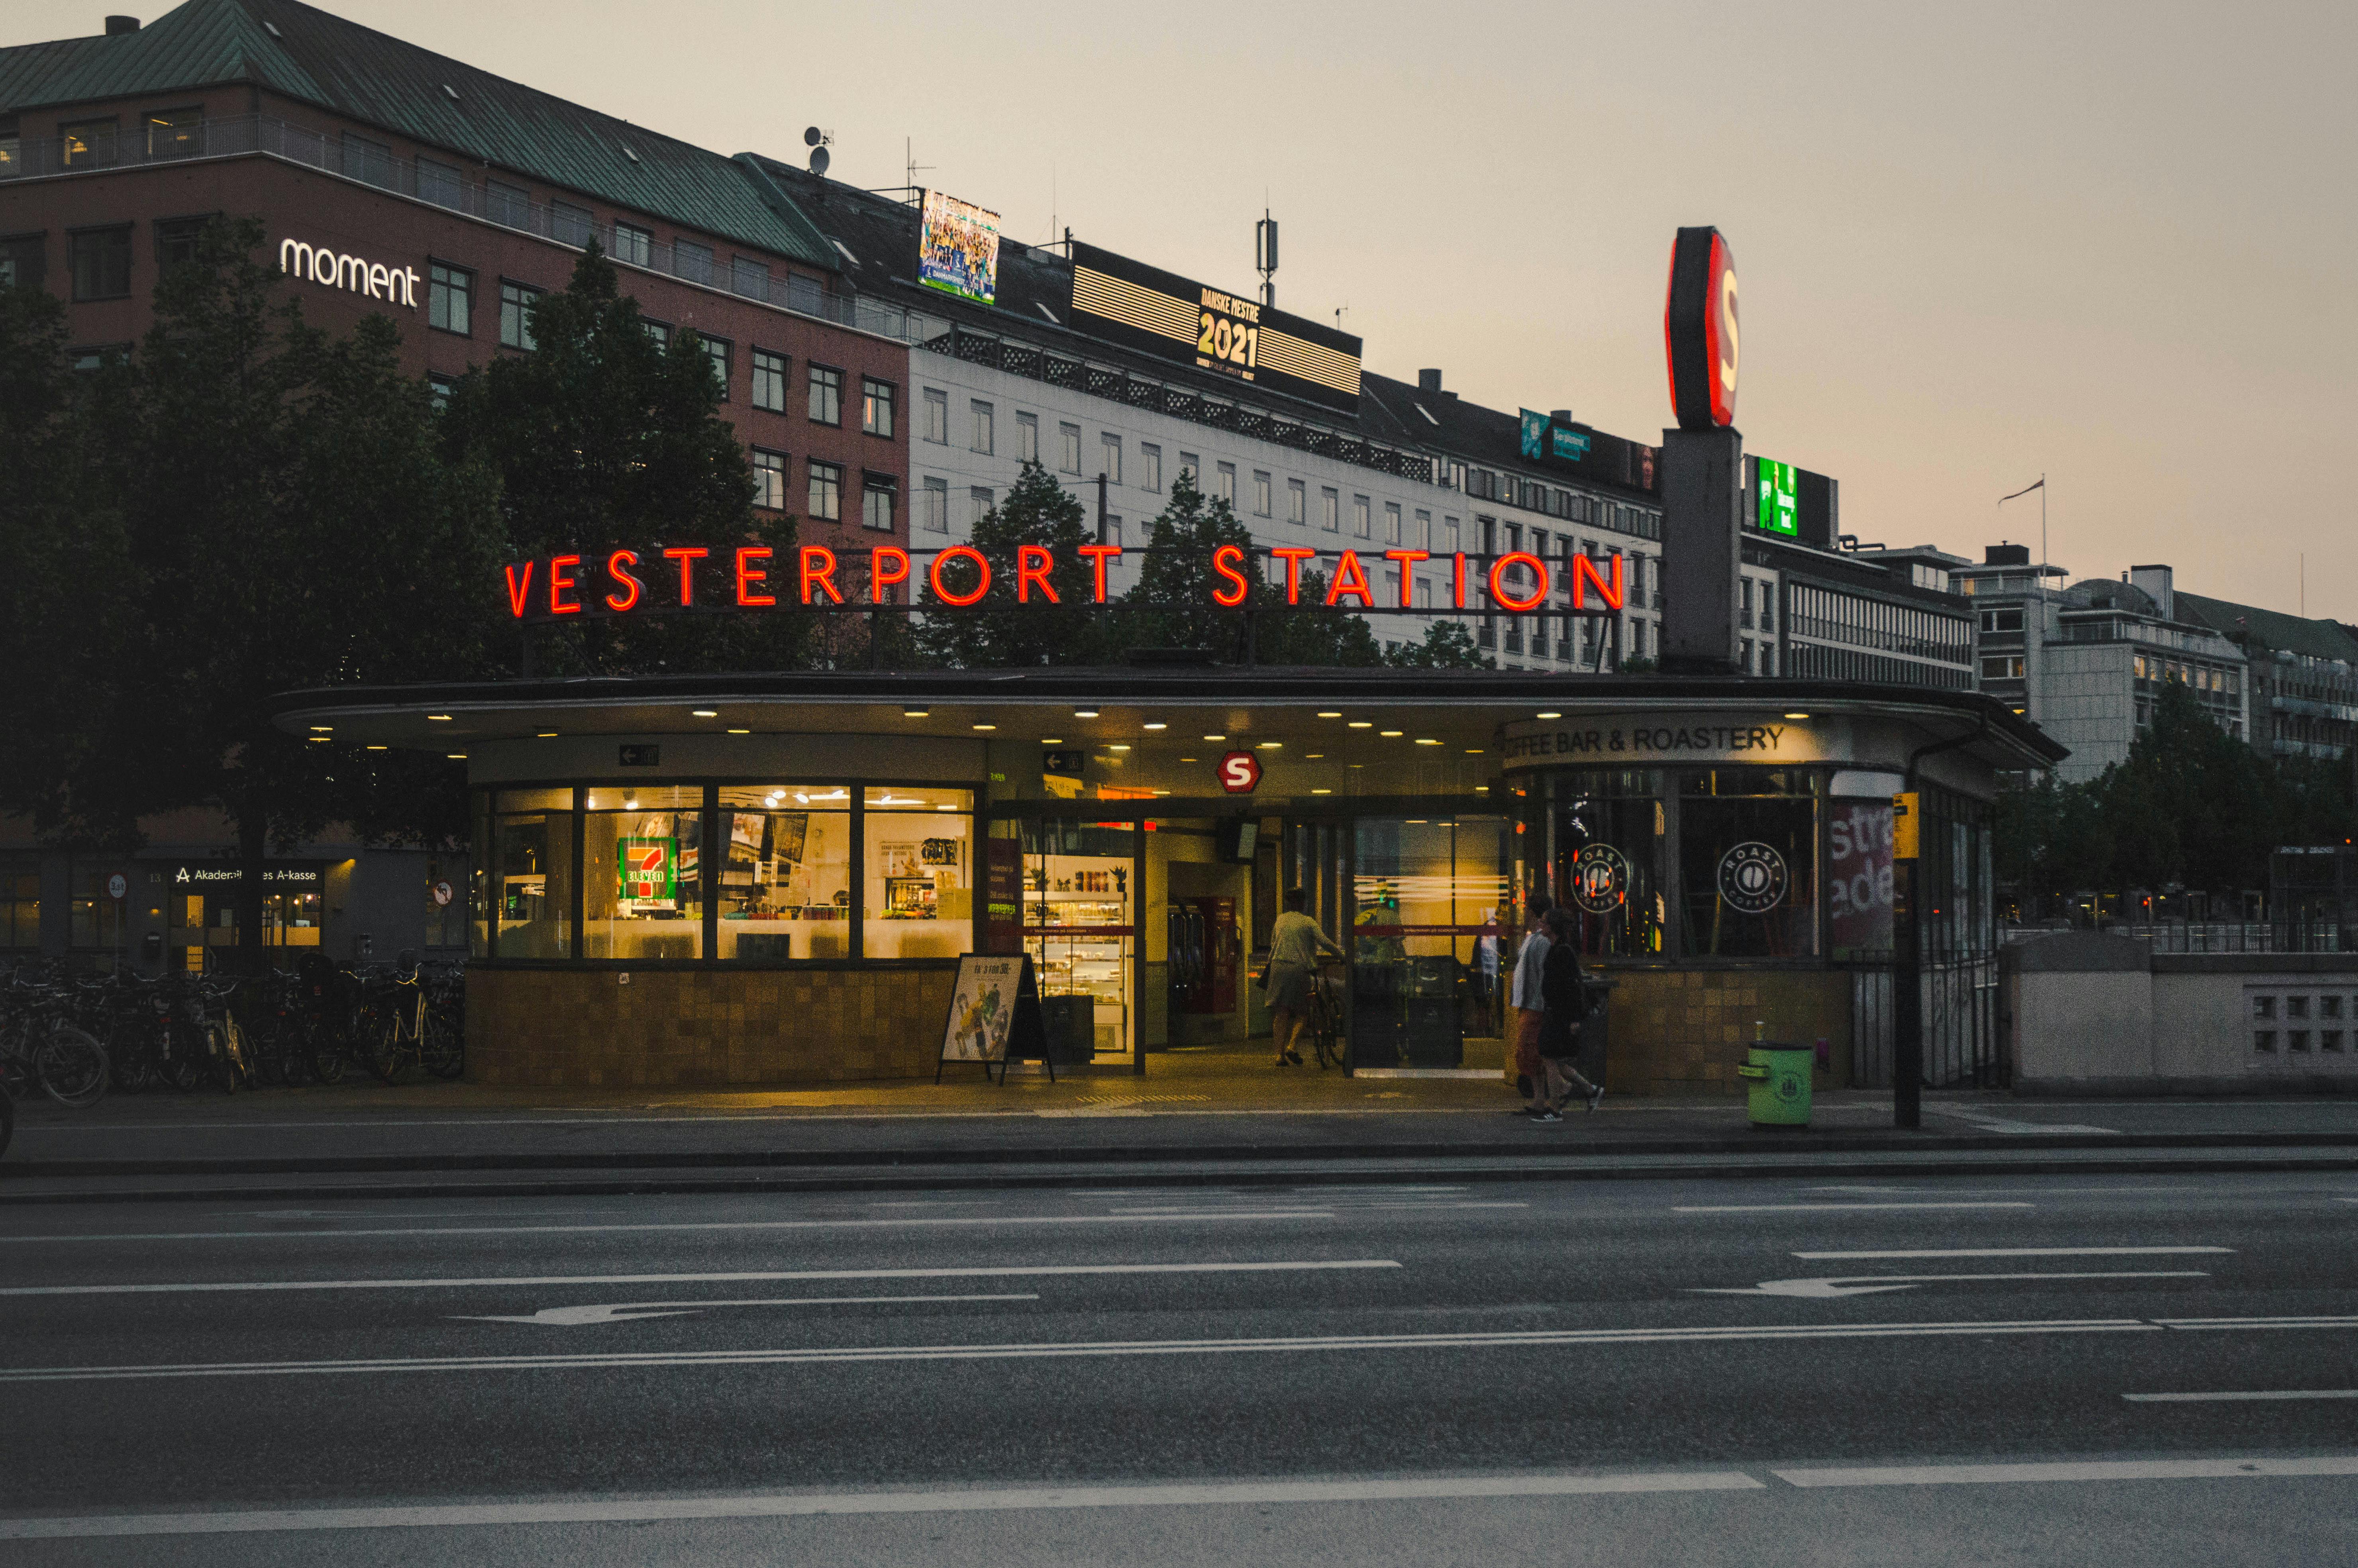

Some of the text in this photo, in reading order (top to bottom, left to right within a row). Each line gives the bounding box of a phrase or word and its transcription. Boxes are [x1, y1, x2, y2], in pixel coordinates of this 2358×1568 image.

[281, 238, 420, 308] moment
[1201, 288, 1259, 324] DANSKE MESTRE
[1198, 312, 1258, 368] 2021
[1720, 269, 1738, 392] S
[505, 545, 1623, 617] VESTERPORT STATION
[1557, 731, 1601, 753] BAR
[1609, 729, 1625, 751] &
[1634, 727, 1784, 750] ROASTERY
[1227, 758, 1251, 786] S
[276, 870, 316, 880] A-kasse
[1724, 846, 1780, 869] ROAST
